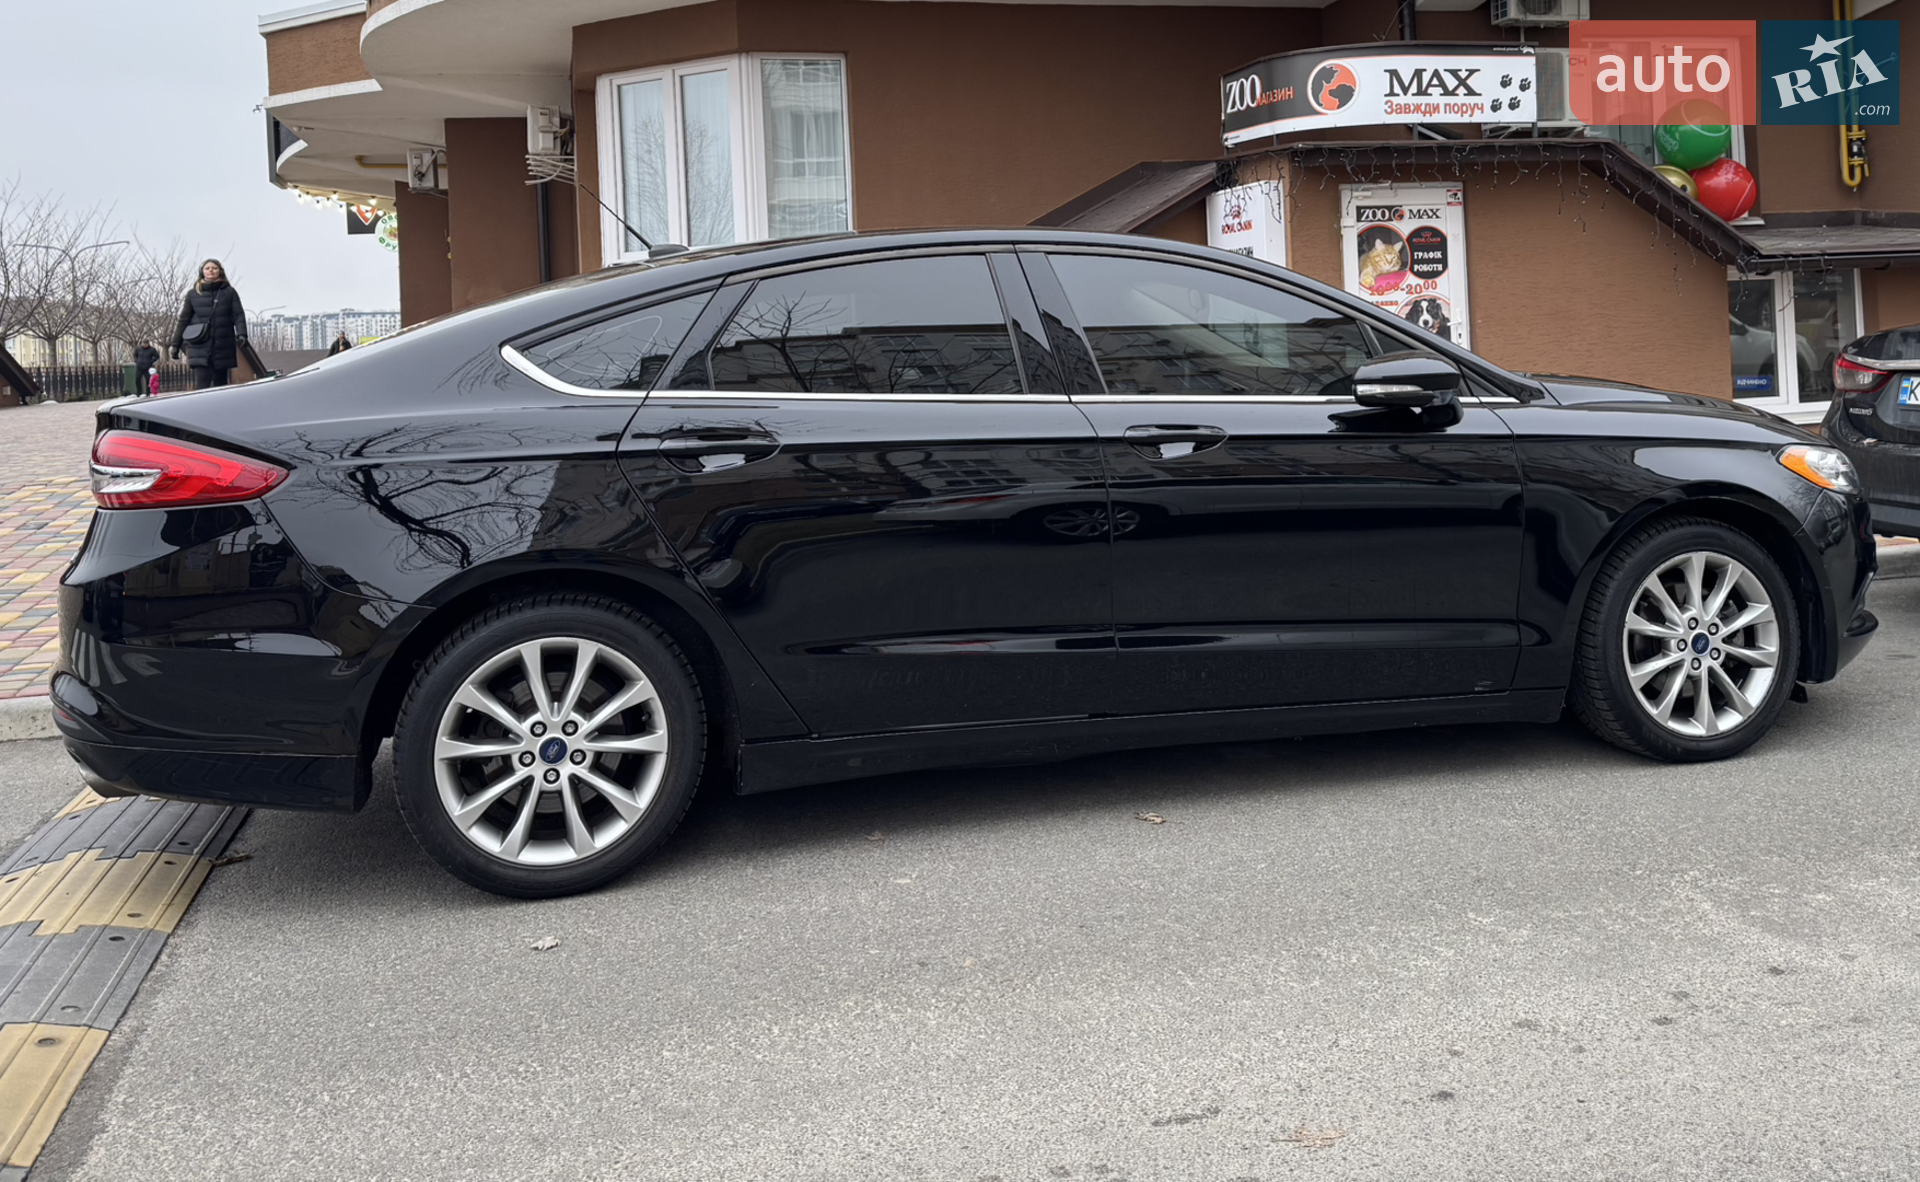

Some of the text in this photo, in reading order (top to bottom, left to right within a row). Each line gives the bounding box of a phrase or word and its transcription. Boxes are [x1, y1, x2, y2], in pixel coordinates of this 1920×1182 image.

[1384, 68, 1482, 97] MAX
[1226, 74, 1260, 114] ZOO
[1384, 100, 1485, 118] Завжди поруч
[1360, 208, 1441, 221] ZOO MAX
[1414, 251, 1442, 259] ГРАФІК
